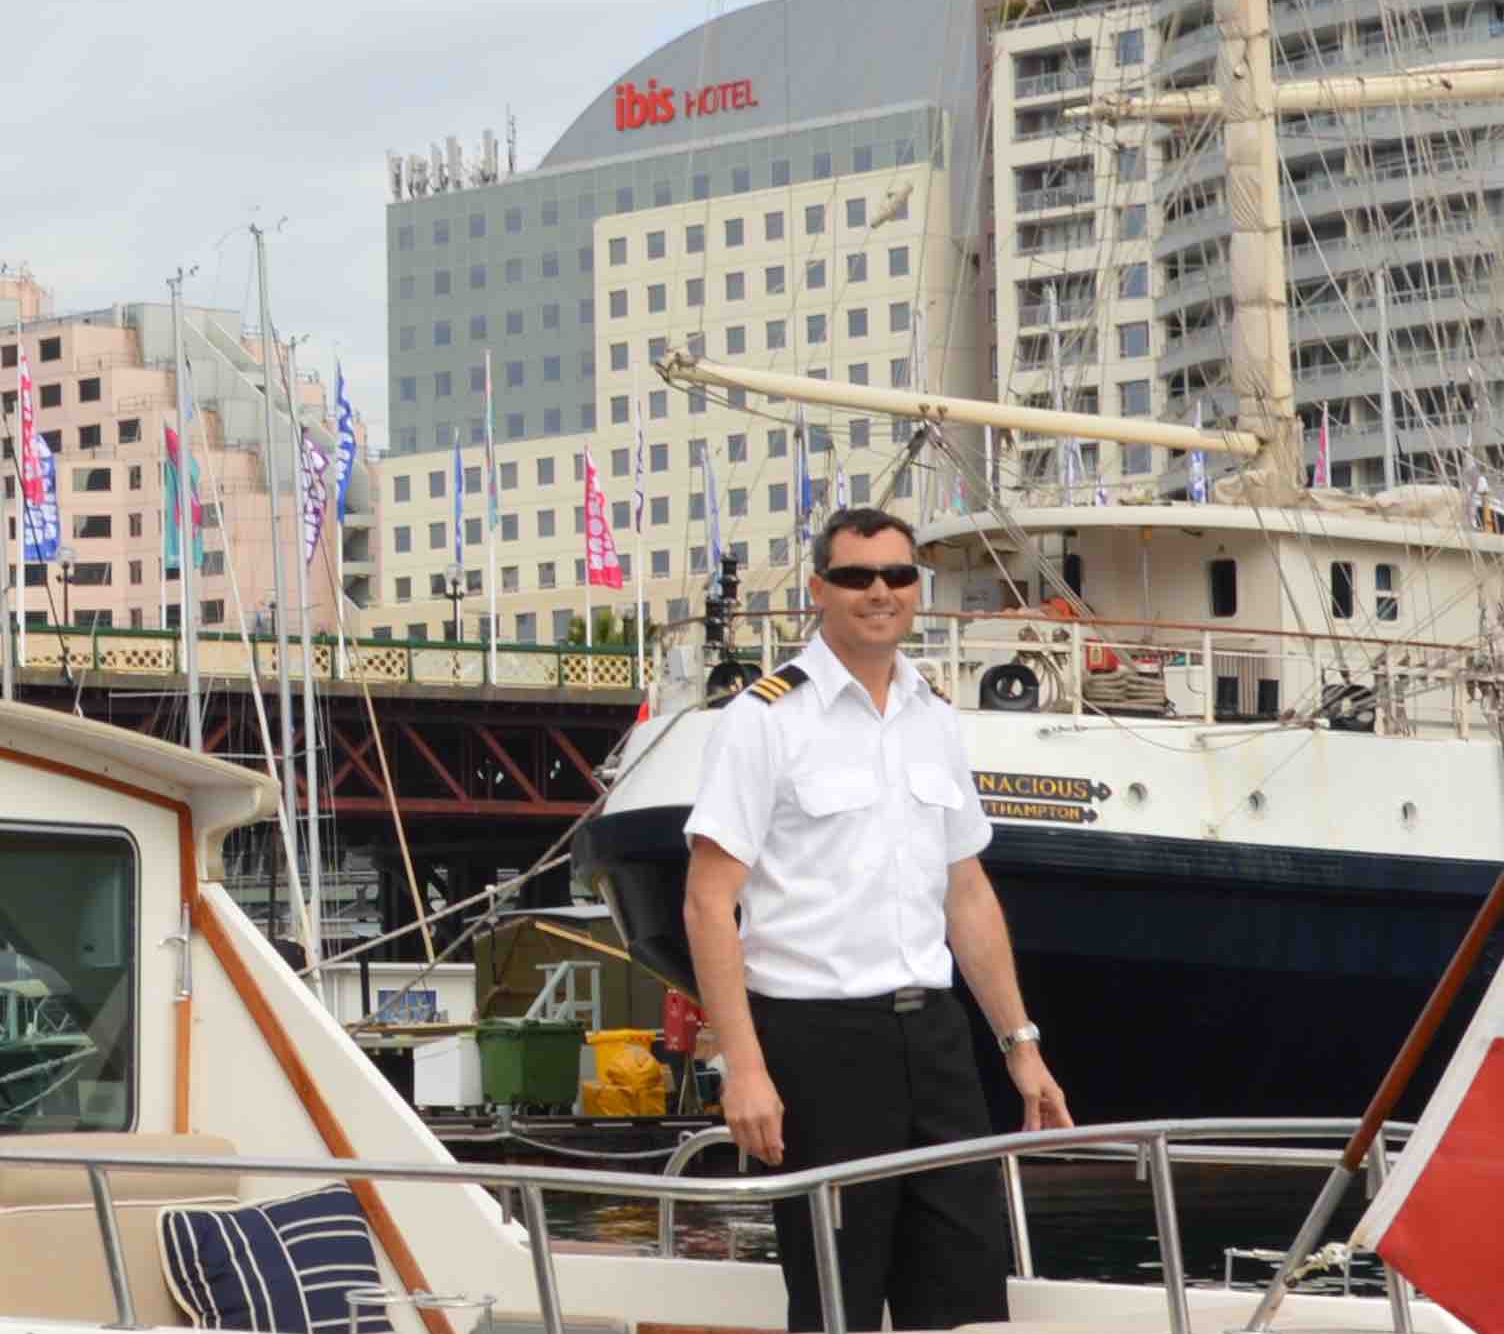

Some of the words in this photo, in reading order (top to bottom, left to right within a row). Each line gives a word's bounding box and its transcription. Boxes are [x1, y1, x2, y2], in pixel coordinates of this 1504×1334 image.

[615, 78, 675, 133] ibis
[683, 79, 759, 119] HOTEL
[975, 773, 1089, 800] NACIOUS
